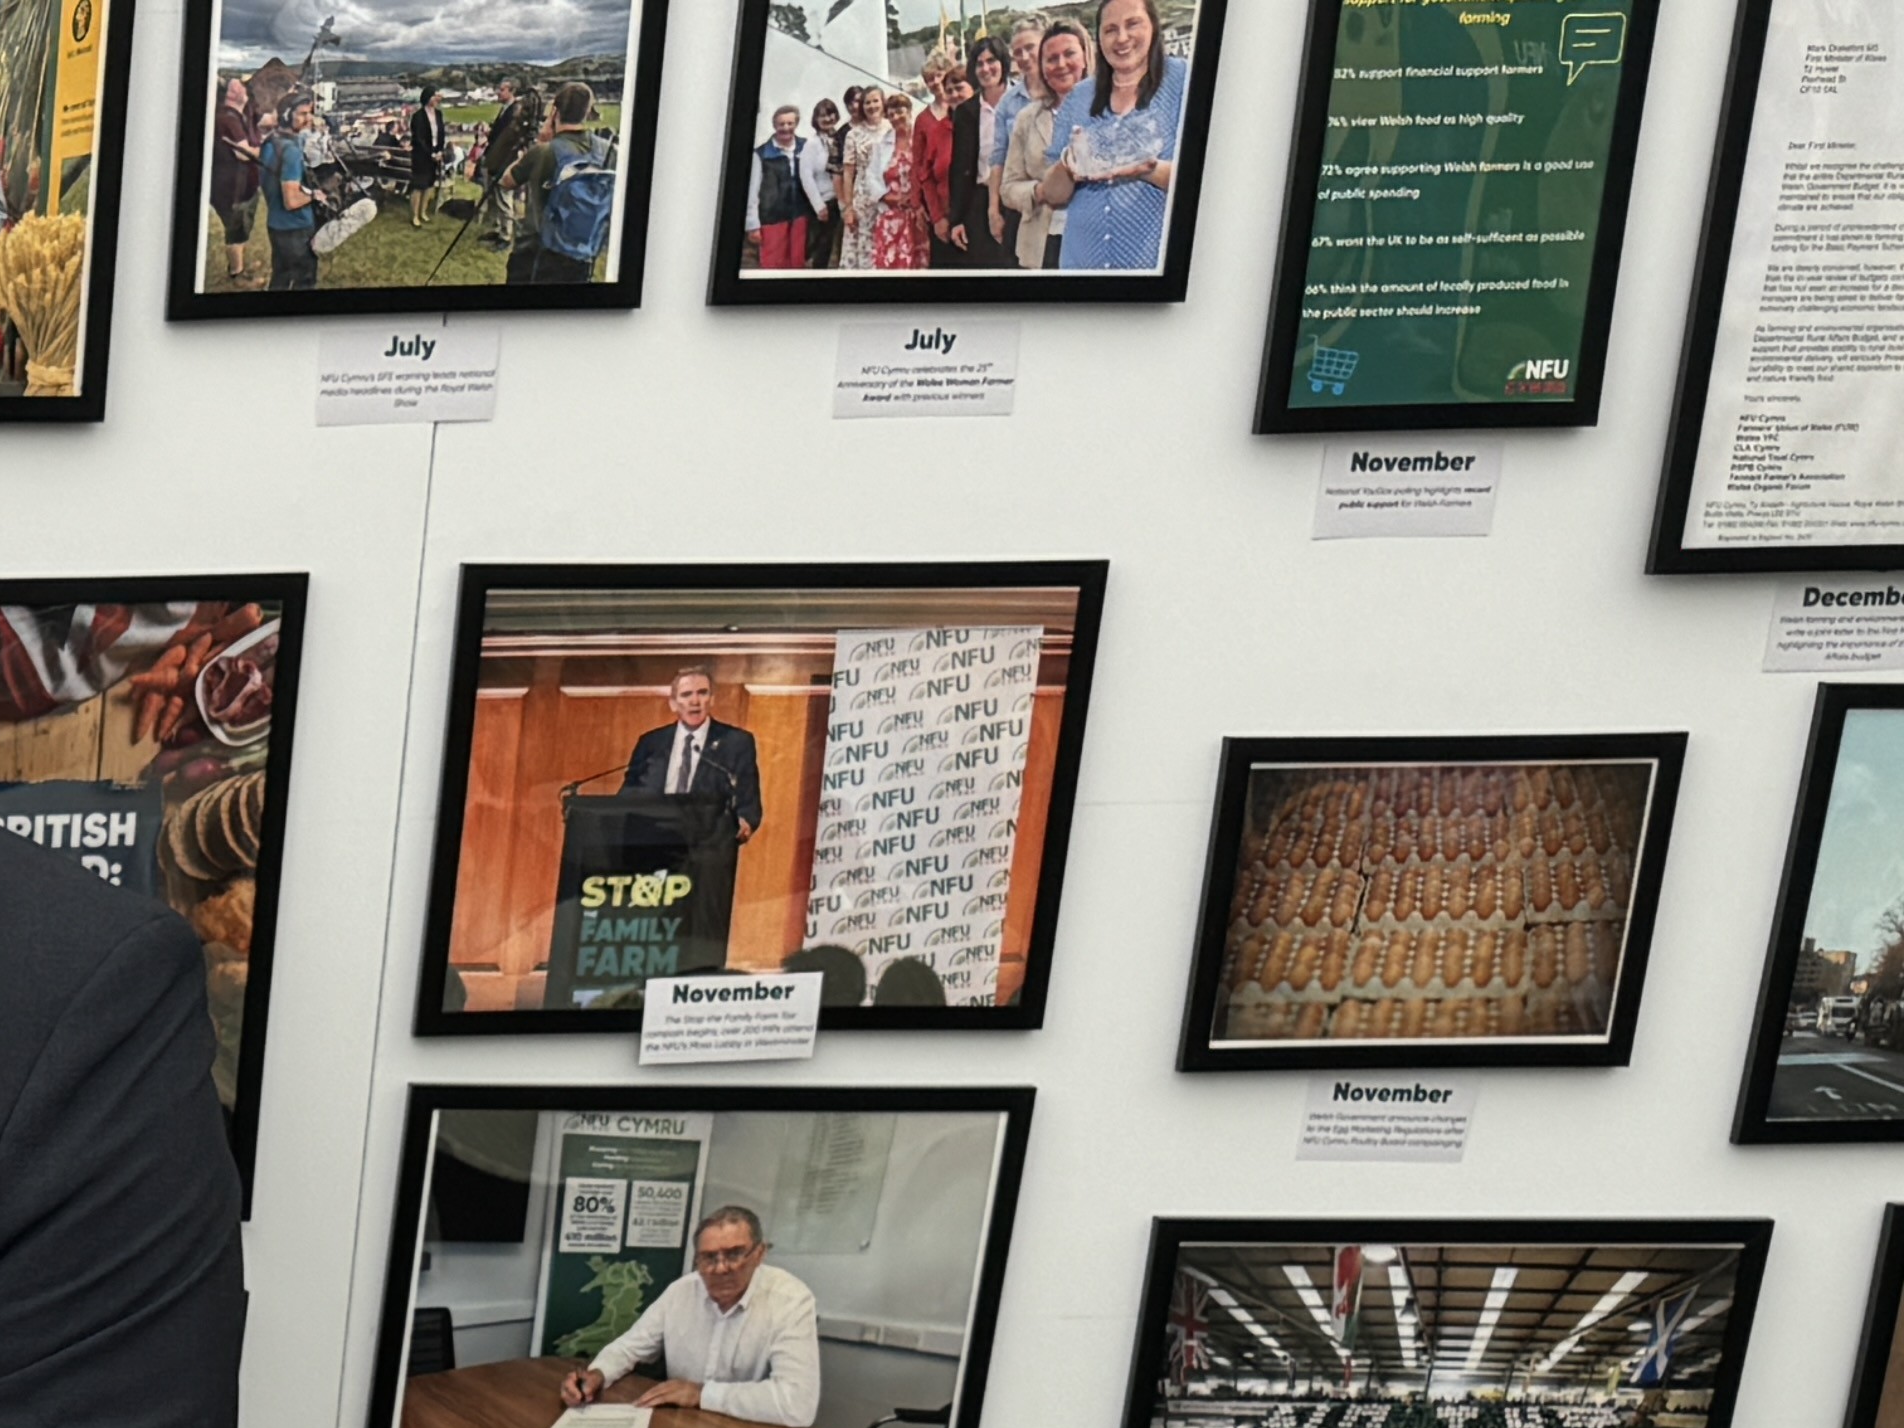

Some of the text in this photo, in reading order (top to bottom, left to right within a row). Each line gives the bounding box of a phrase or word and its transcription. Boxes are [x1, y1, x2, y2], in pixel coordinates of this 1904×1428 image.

[1459, 12, 1511, 25] farming
[1502, 66, 1543, 75] farmers
[1459, 113, 1524, 125] high quality
[1381, 162, 1441, 176] supporting
[1541, 231, 1584, 243] possible
[1477, 279, 1529, 292] produced
[1435, 305, 1480, 316] increase
[384, 334, 436, 361] July
[904, 328, 956, 354] July
[1525, 359, 1569, 380] NFU
[1351, 452, 1475, 472] November
[952, 646, 995, 669] NFU
[927, 674, 971, 697] NFU
[905, 854, 949, 877] NFU
[581, 918, 684, 944] FAMILY
[577, 947, 678, 977] FARM
[673, 983, 795, 1005] November
[1333, 1083, 1452, 1103] November
[617, 1114, 687, 1136] CYMRU
[572, 1193, 616, 1216] 80%
